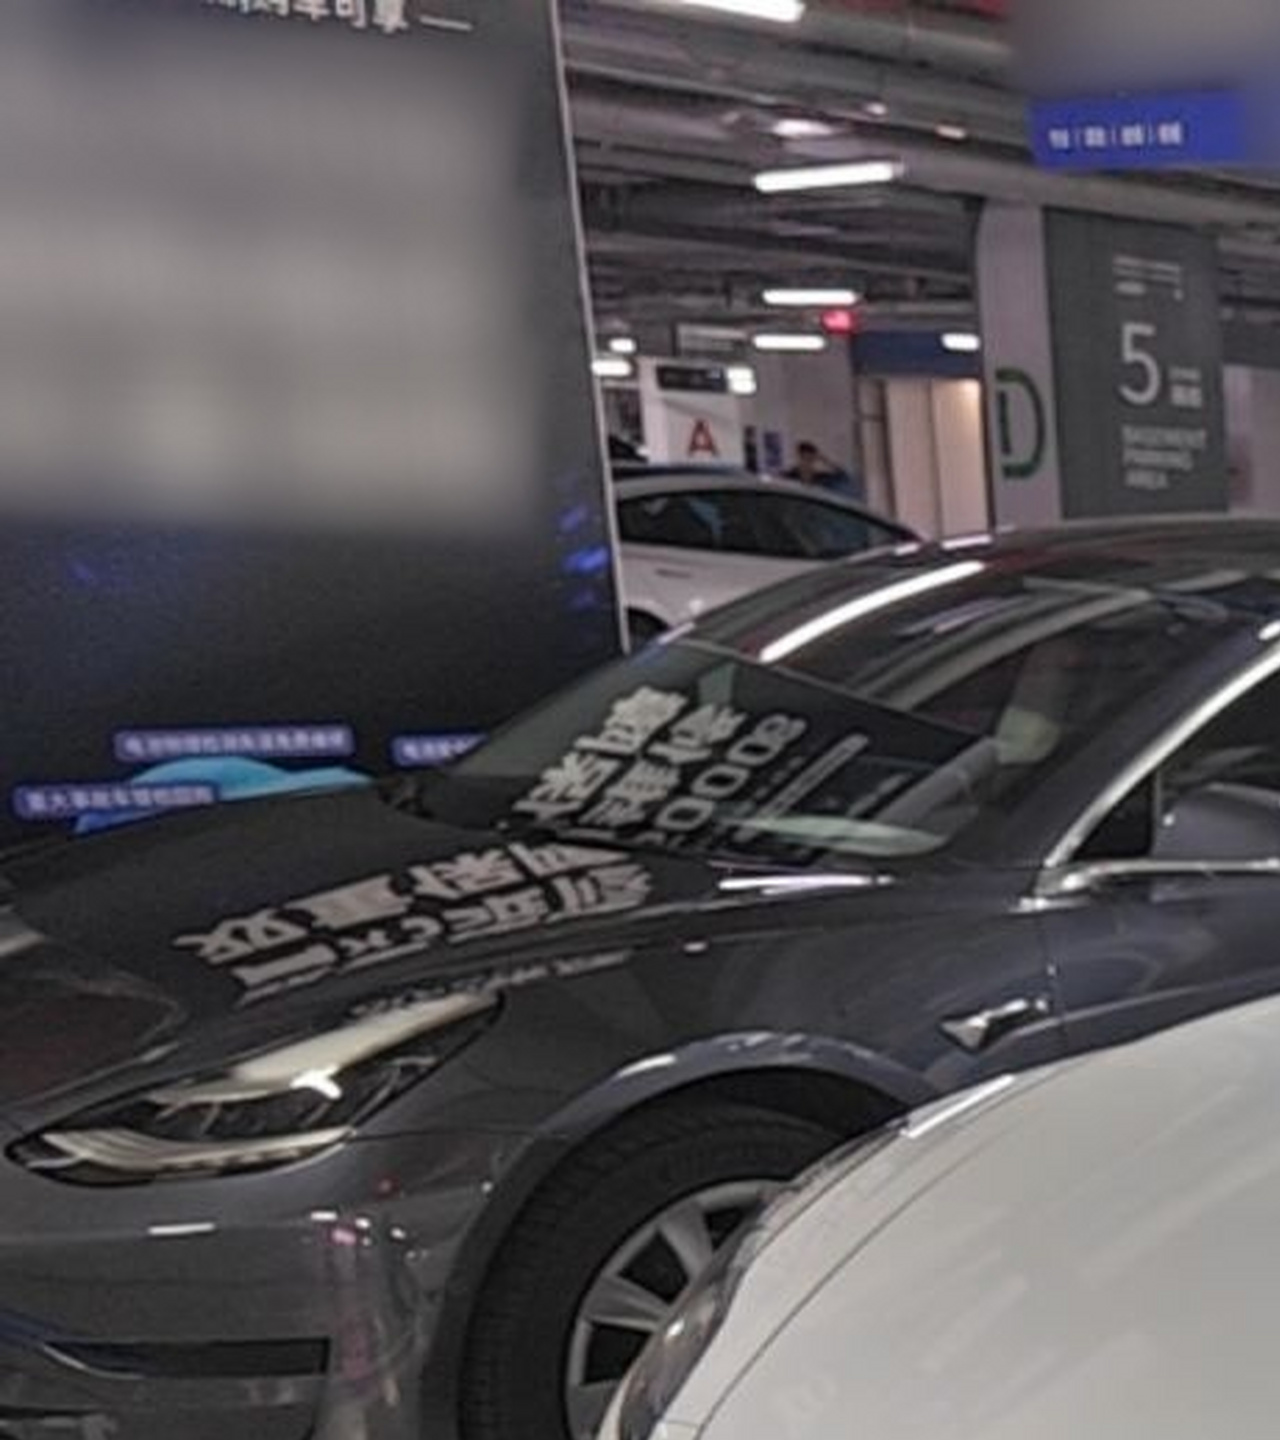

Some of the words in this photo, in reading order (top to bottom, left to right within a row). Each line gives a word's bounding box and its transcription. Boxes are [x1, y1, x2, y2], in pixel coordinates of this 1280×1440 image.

[1119, 321, 1162, 405] 5
[687, 418, 719, 458] A
[994, 367, 1046, 480] D
